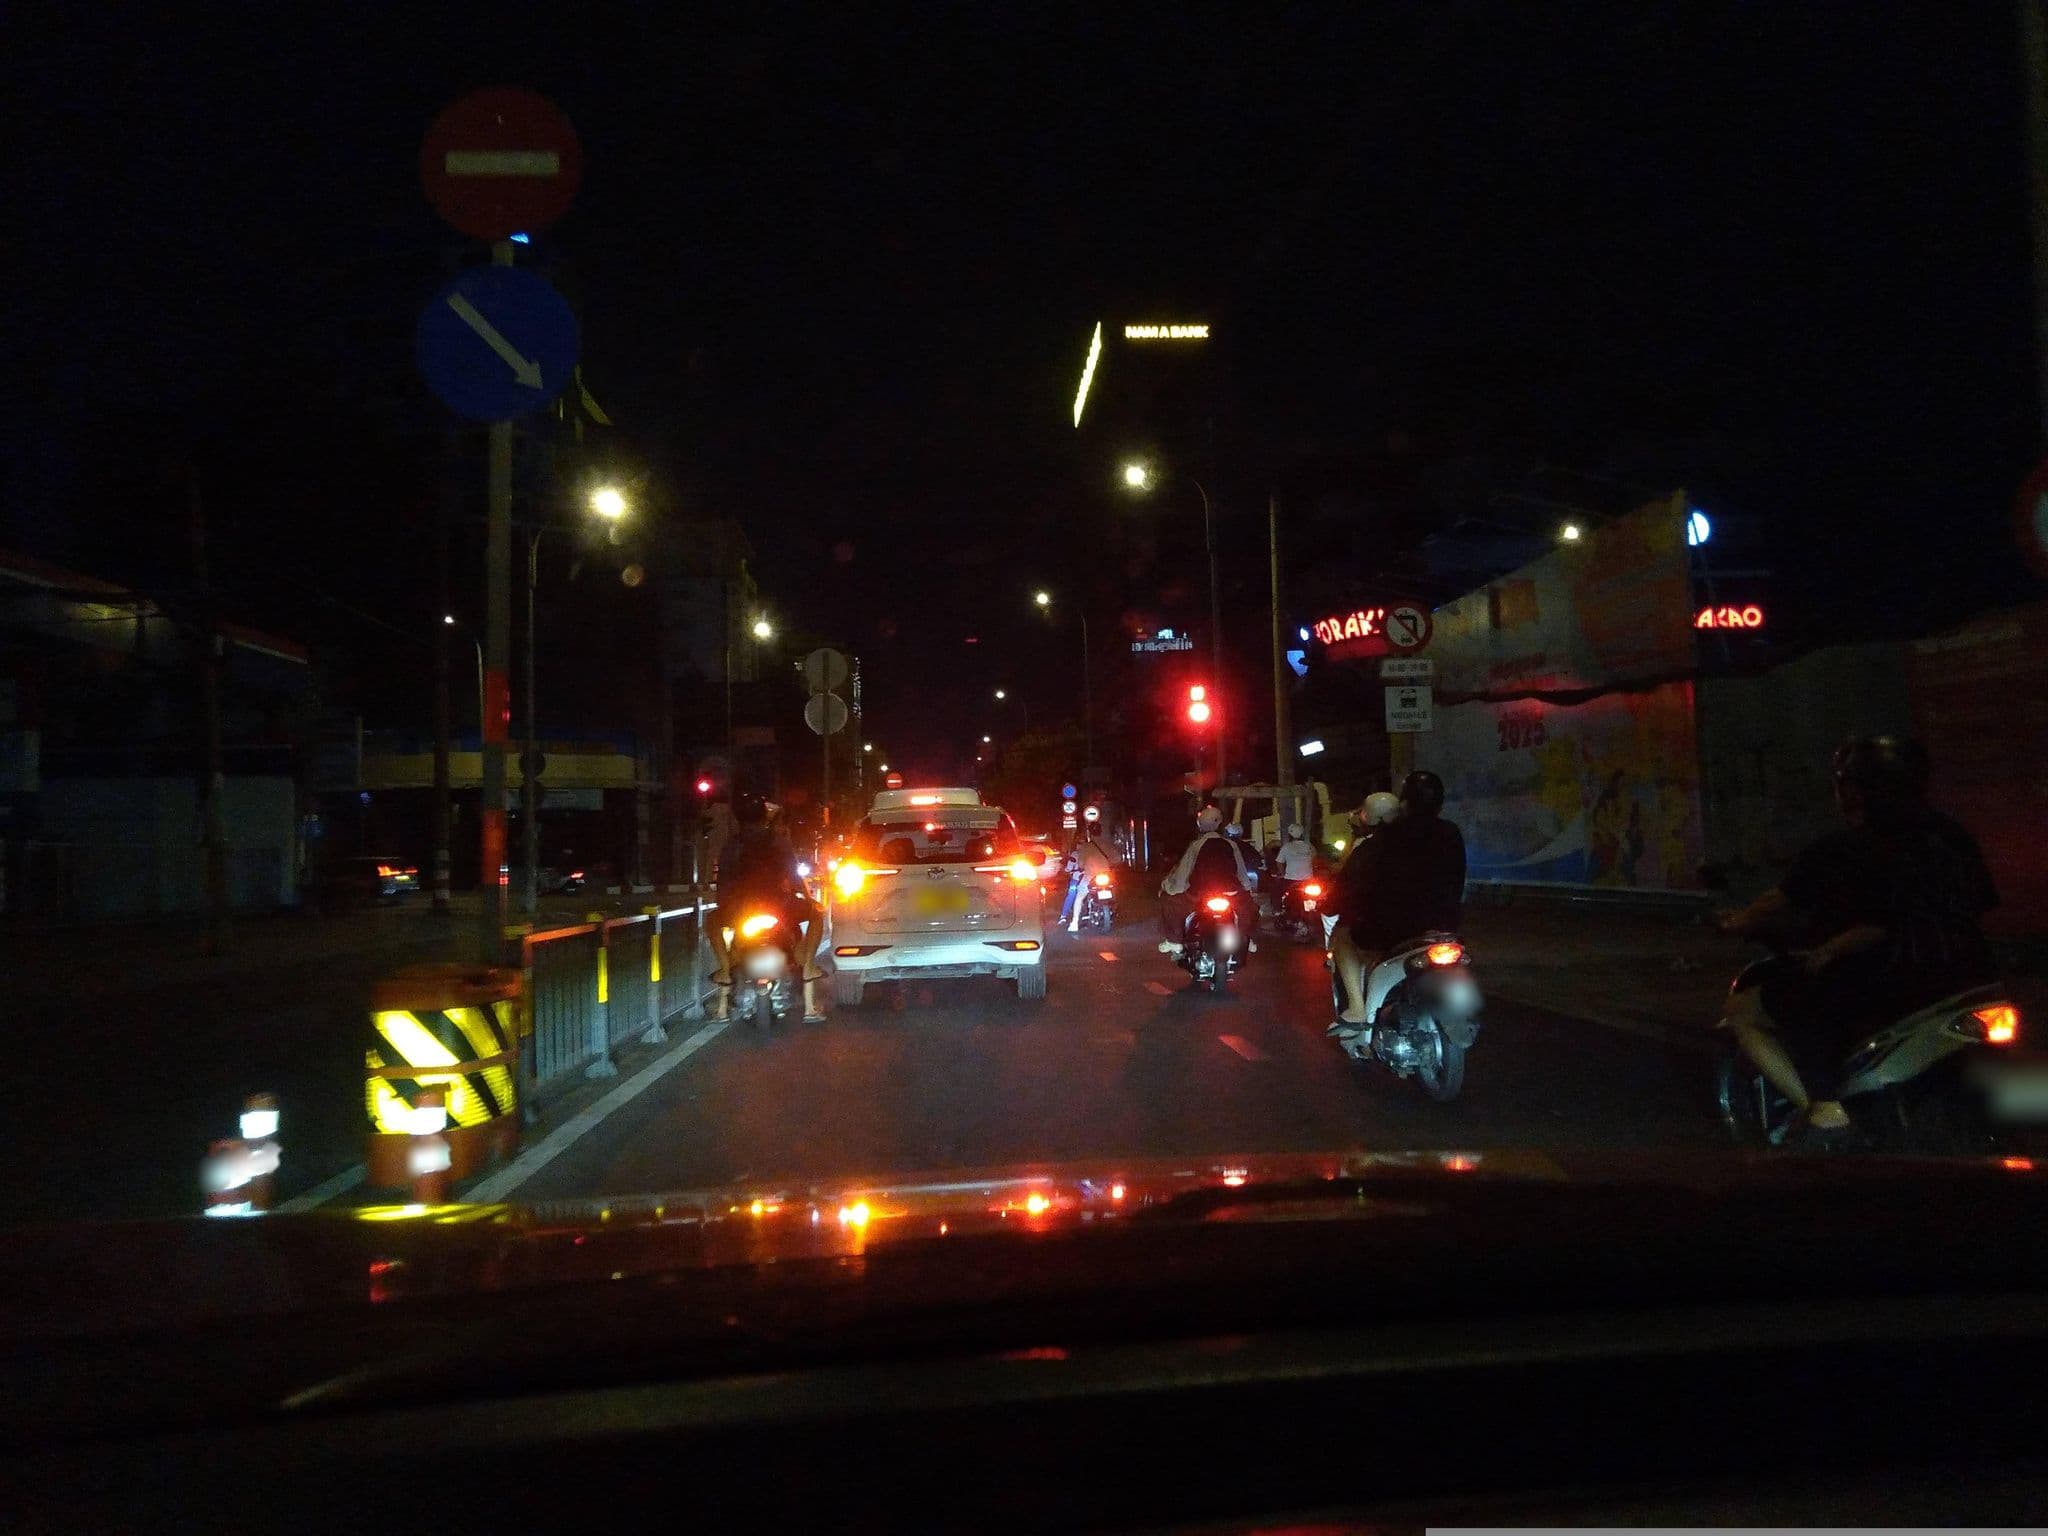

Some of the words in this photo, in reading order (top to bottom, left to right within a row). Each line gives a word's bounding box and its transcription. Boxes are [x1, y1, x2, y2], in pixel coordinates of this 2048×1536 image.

[1125, 326, 1158, 339] NAM
[1170, 326, 1209, 339] BANK
[1694, 605, 1763, 629] AKAO
